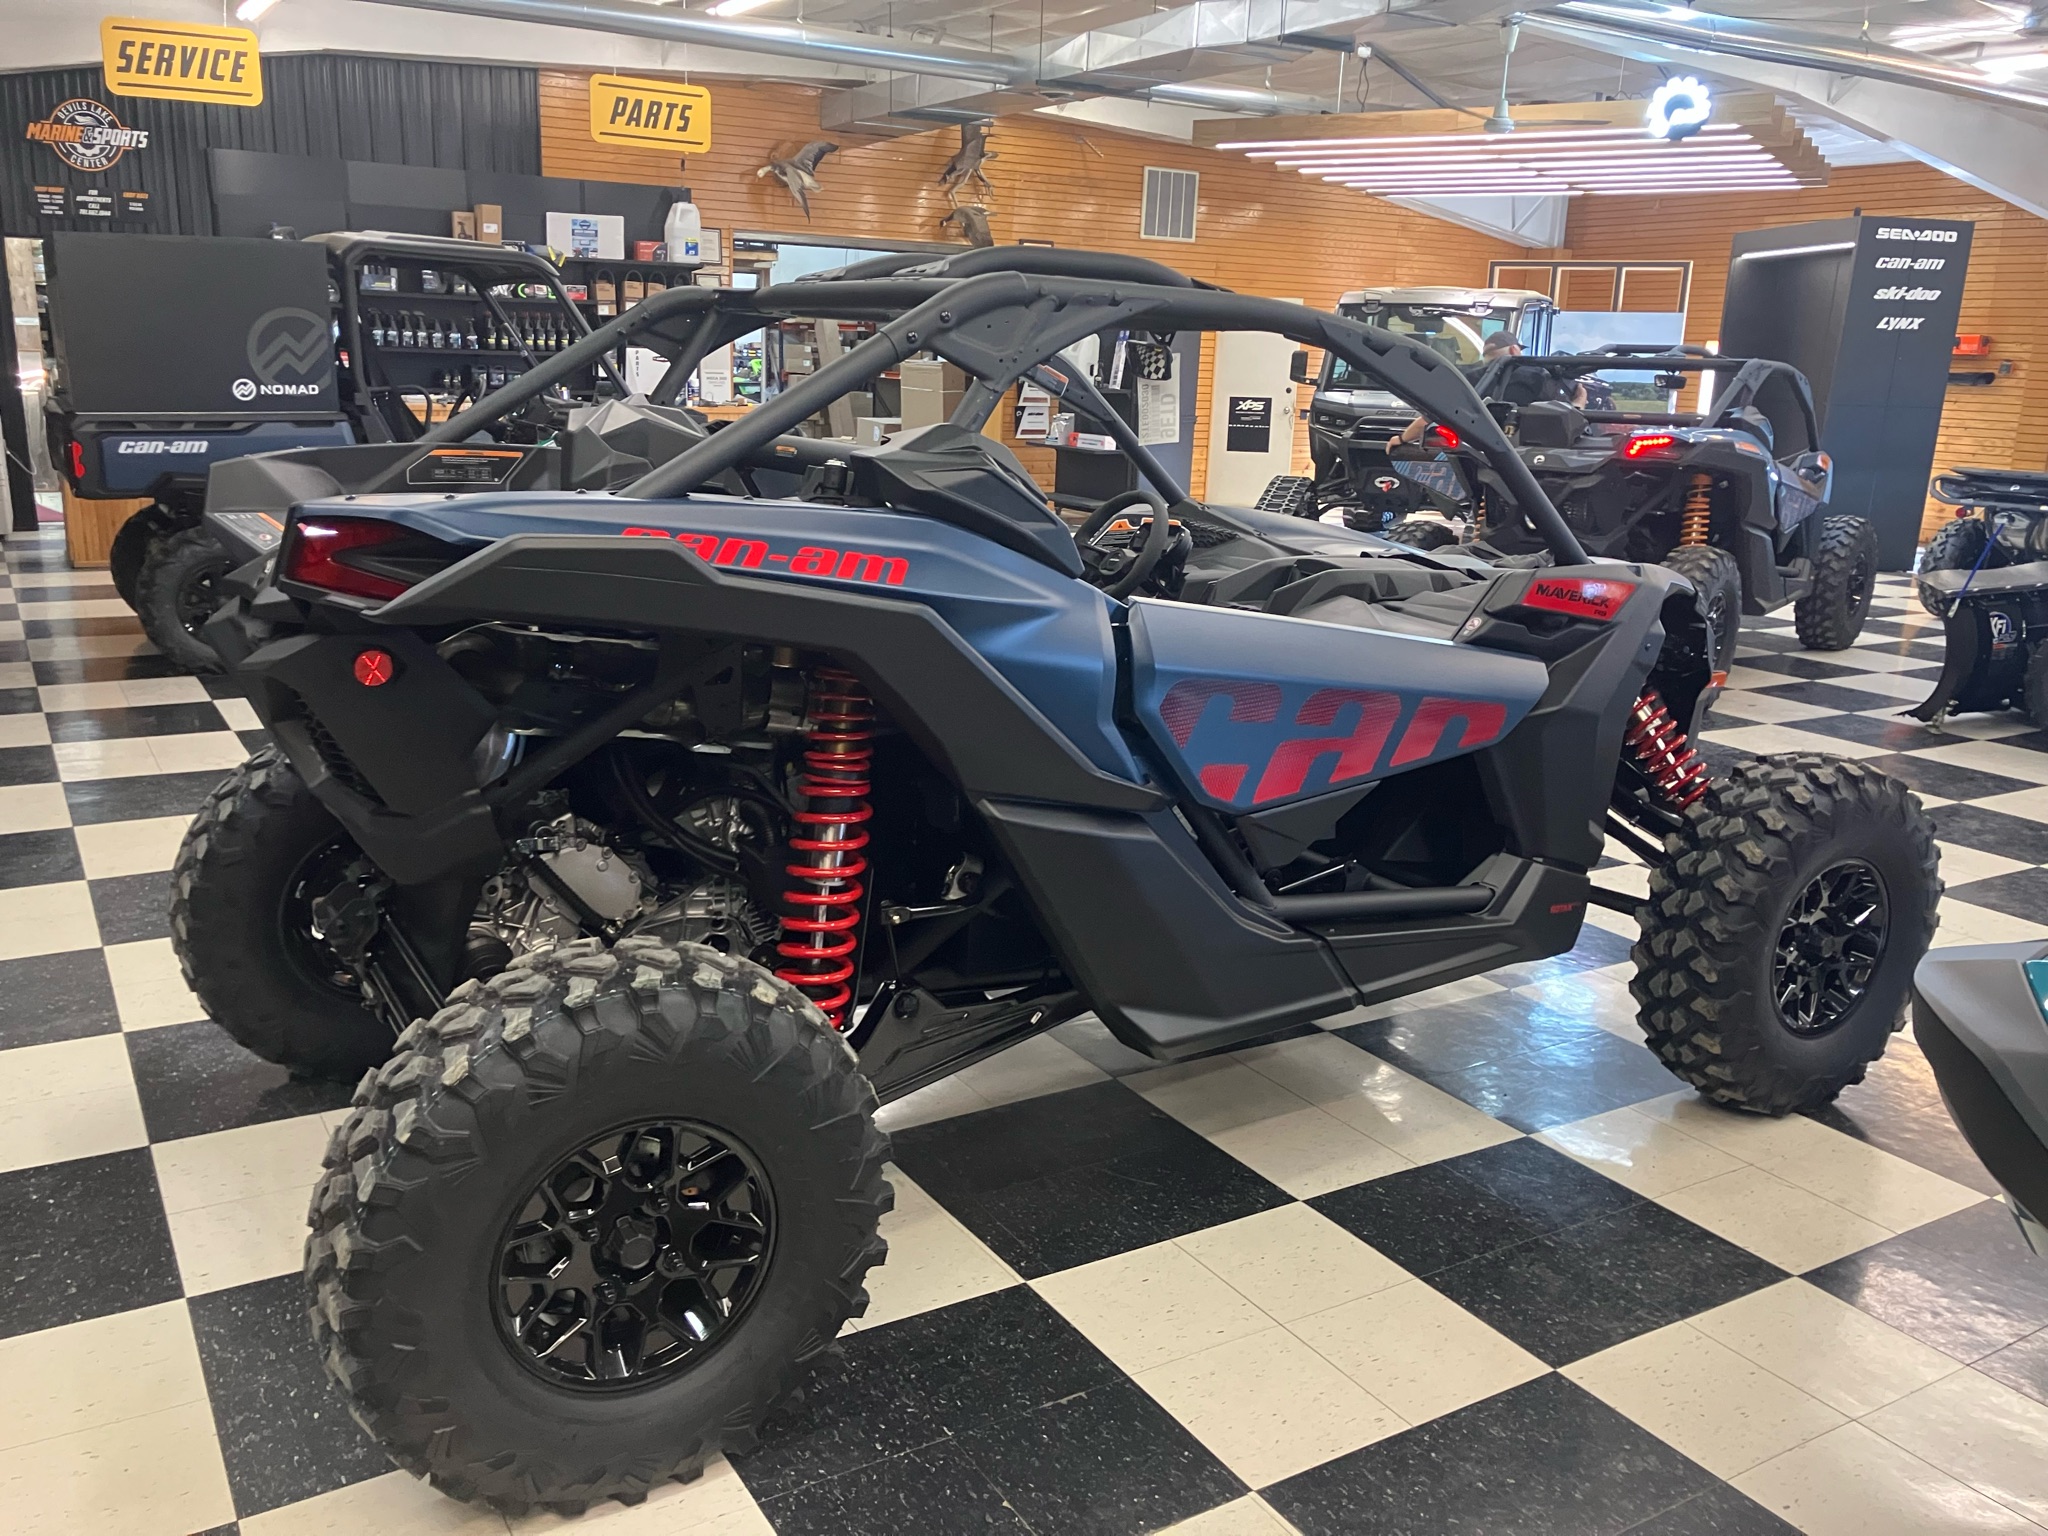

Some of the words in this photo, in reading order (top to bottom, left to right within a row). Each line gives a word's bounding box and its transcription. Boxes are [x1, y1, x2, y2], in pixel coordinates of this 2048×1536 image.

[116, 40, 249, 83] SERVICE
[57, 102, 88, 119] DEVILS
[91, 104, 113, 123] LAKE
[609, 96, 693, 133] PARTS
[70, 154, 109, 168] CENTER
[1875, 257, 1946, 270] can-am
[1873, 286, 1942, 301] ski-doo
[1875, 316, 1925, 330] LYNX
[260, 384, 319, 395] NOMAD
[1235, 399, 1266, 411] XPS
[118, 440, 209, 454] can-am
[621, 527, 910, 586] an-am
